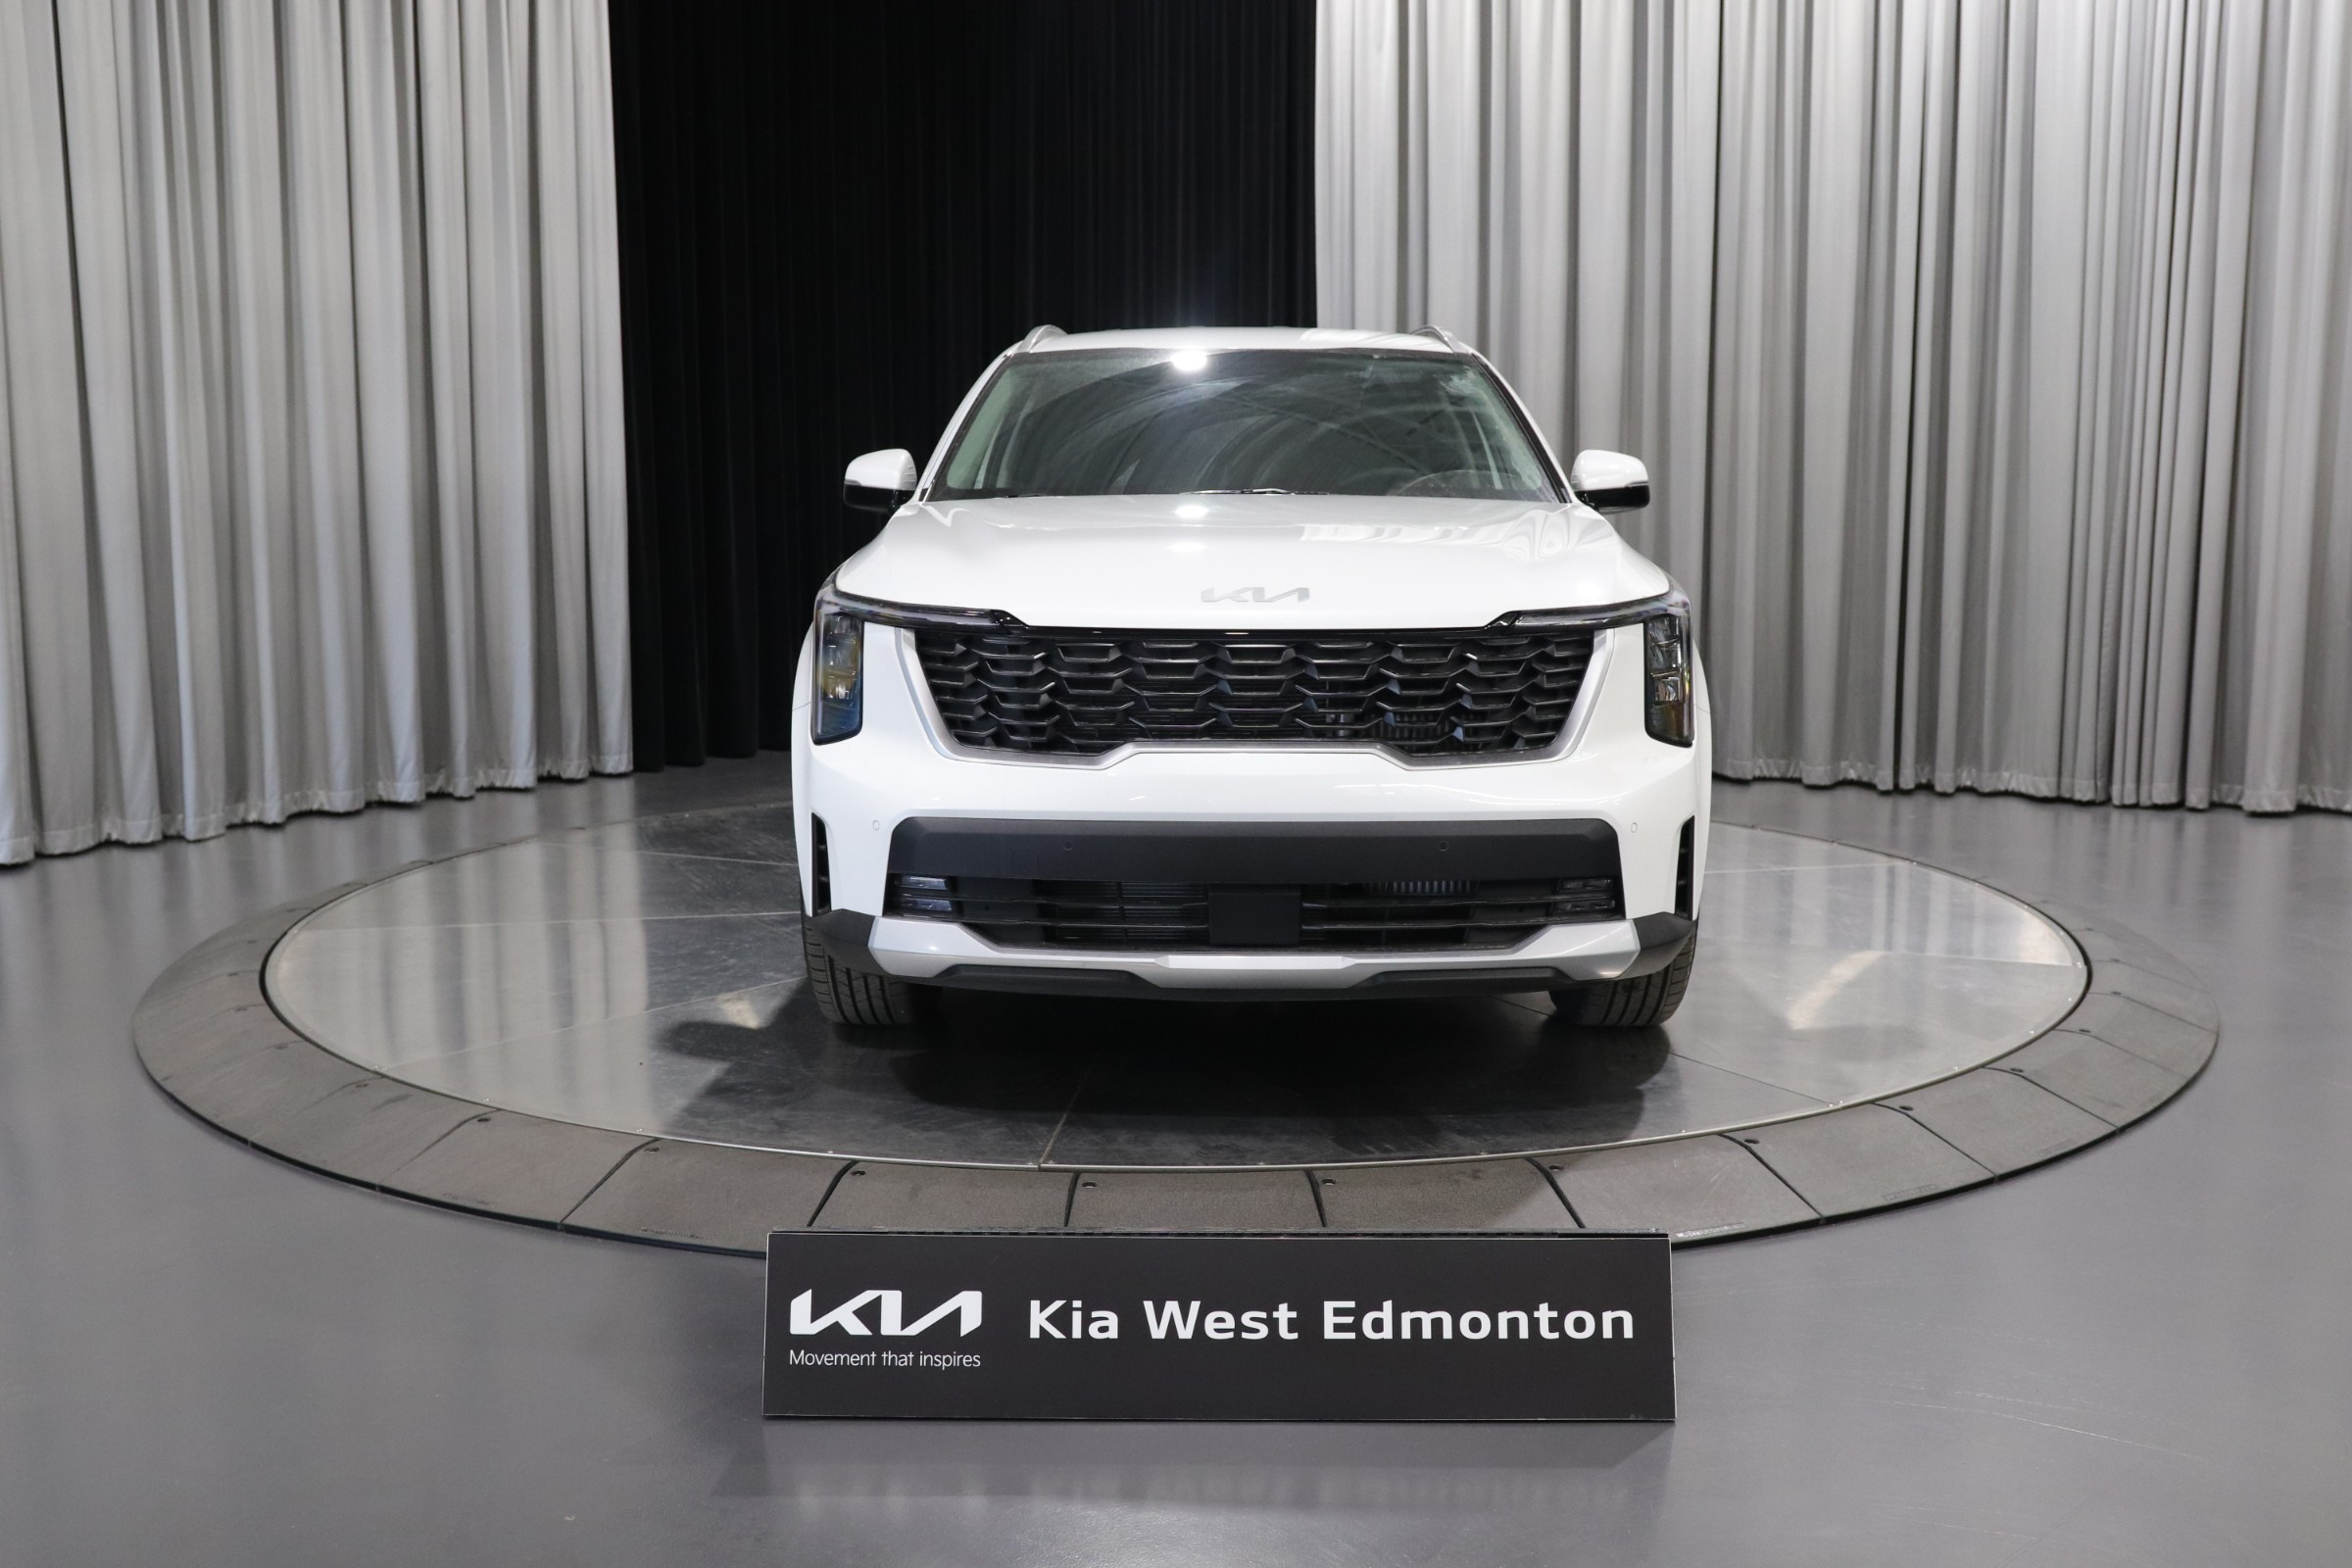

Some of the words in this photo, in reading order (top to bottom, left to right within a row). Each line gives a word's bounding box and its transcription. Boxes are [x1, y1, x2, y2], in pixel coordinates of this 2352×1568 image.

[1200, 586, 1310, 603] KIA
[789, 1288, 983, 1338] KIA
[1029, 1299, 1119, 1340] Kia
[1143, 1299, 1298, 1341] West
[1323, 1299, 1634, 1340] Edmonton
[789, 1349, 877, 1366] Movement
[881, 1349, 915, 1367] that
[919, 1350, 981, 1371] inspires
